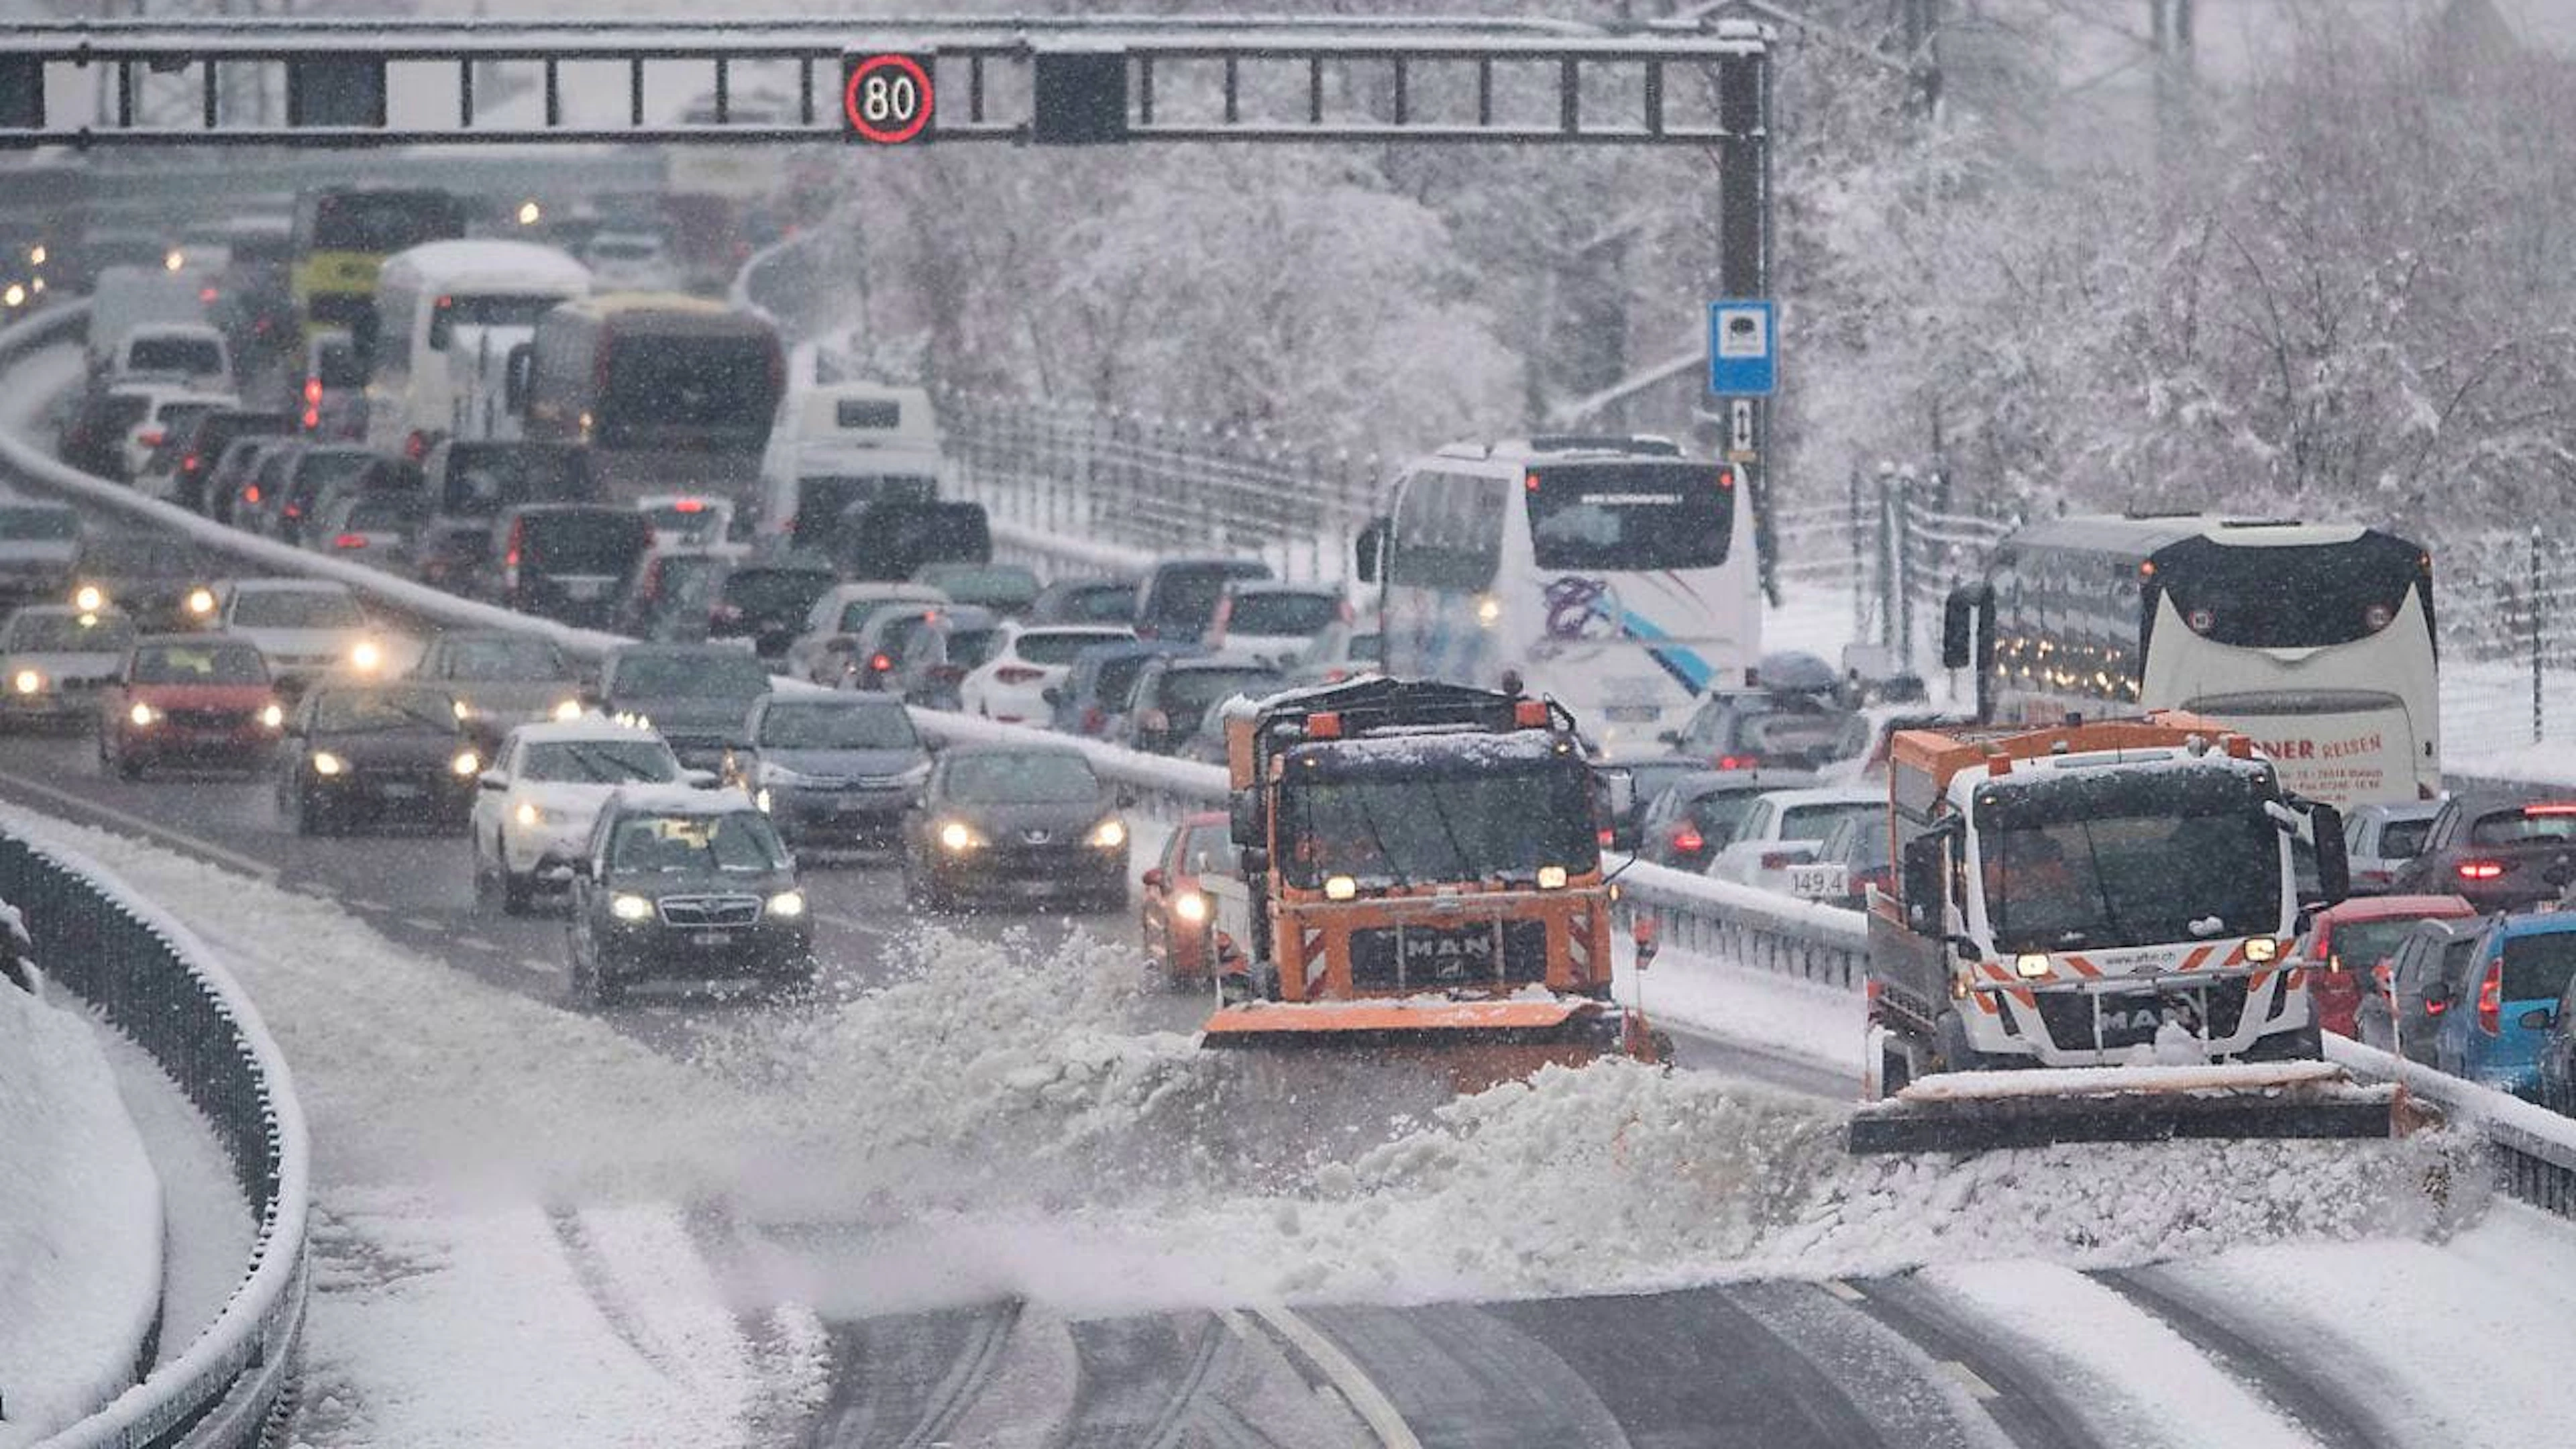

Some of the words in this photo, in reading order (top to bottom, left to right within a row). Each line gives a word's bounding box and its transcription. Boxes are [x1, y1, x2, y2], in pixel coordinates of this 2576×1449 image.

[865, 76, 914, 119] 80
[2322, 733, 2381, 759] REISEN
[1794, 873, 1842, 892] 149.4
[1407, 937, 1490, 958] MAN
